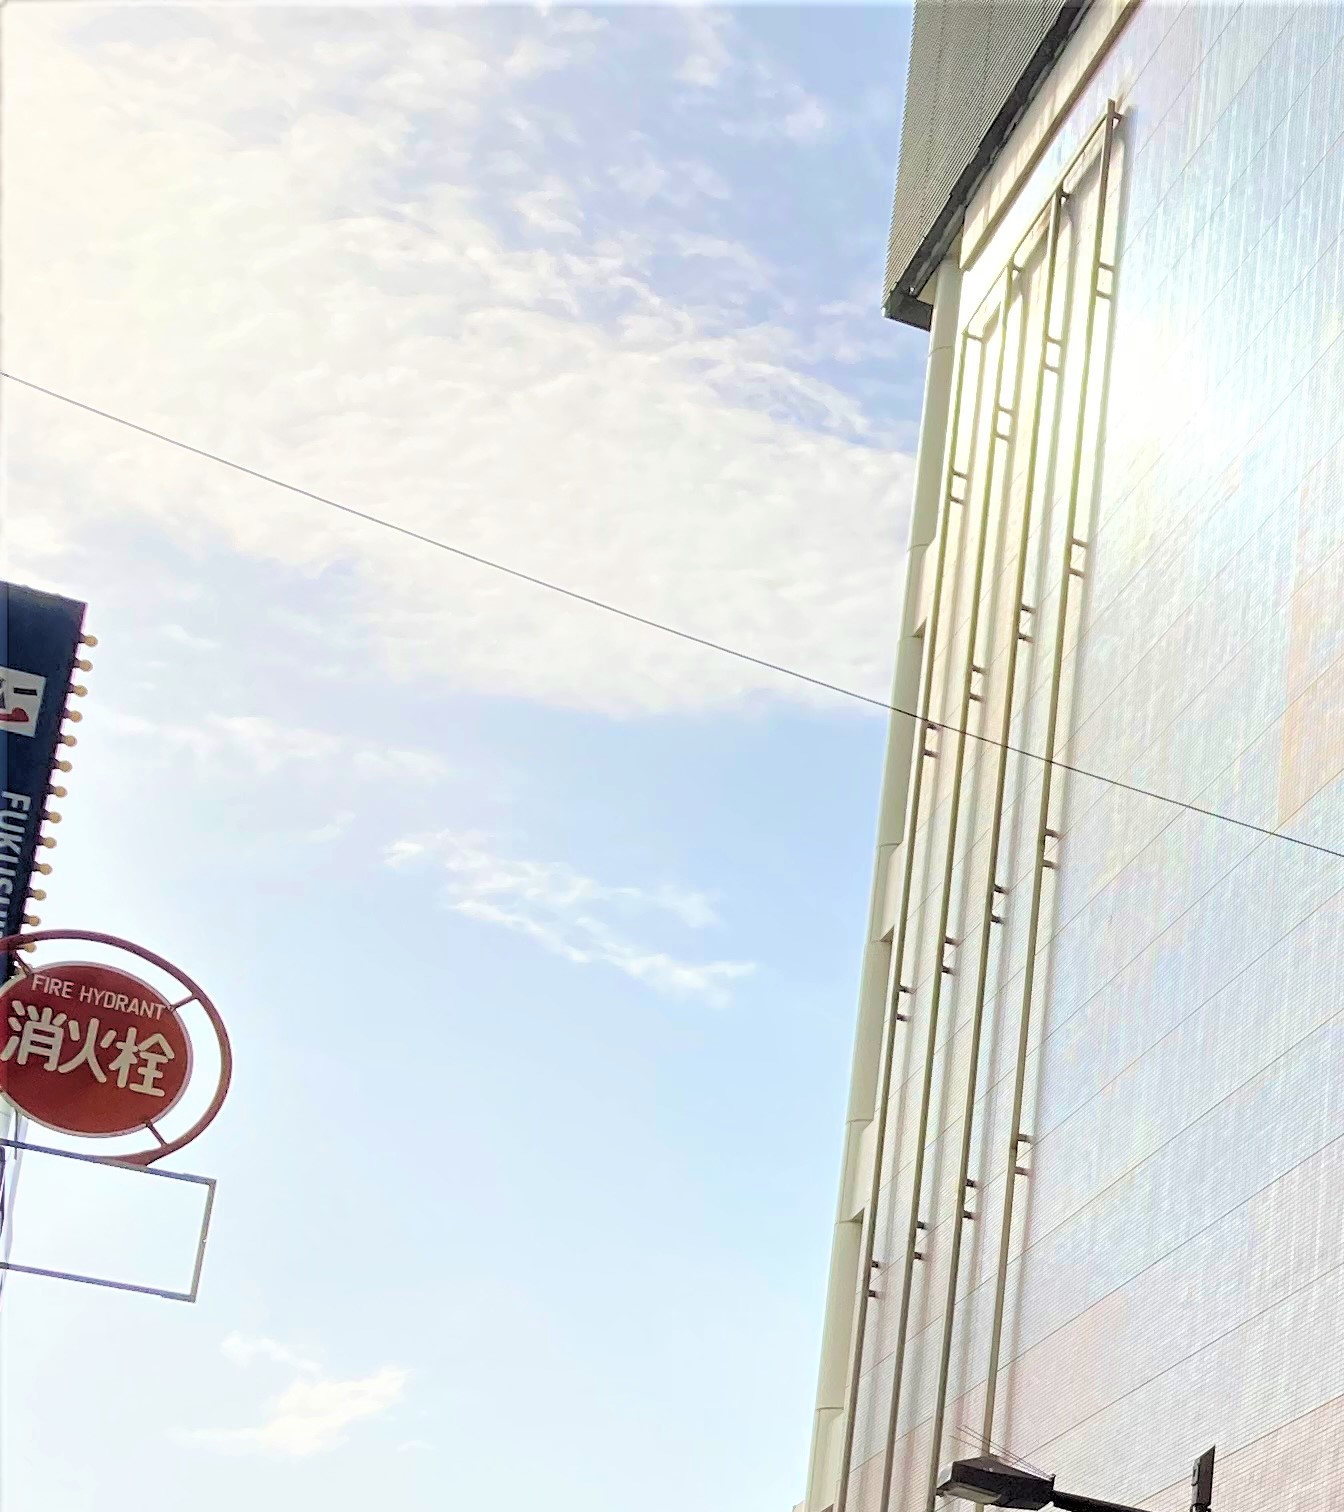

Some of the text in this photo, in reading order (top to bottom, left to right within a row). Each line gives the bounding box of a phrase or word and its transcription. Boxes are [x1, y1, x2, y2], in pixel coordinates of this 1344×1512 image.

[32, 974, 166, 1021] FIRE HYDRANT
[0, 1000, 175, 1097] 消火栓
